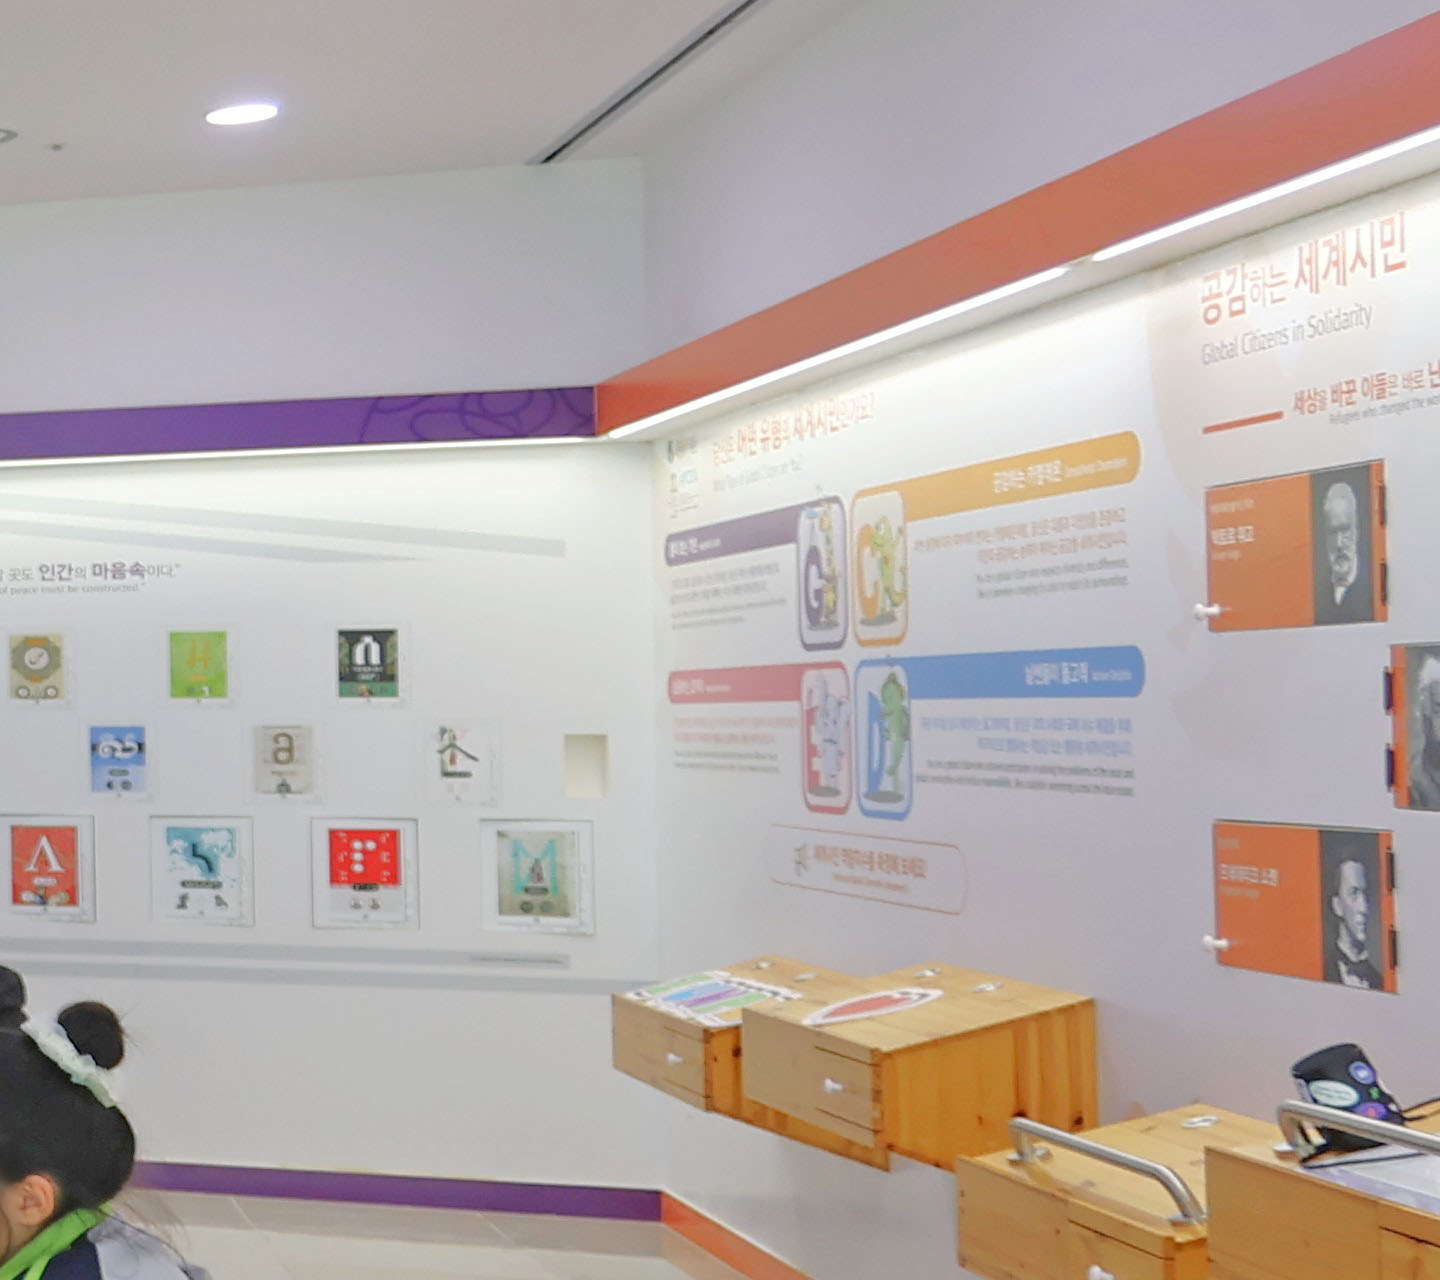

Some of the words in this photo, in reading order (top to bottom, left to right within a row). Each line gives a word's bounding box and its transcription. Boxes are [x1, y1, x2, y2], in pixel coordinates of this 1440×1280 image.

[1201, 263, 1288, 326] 공감하는
[1294, 211, 1407, 296] 세계시민
[1201, 337, 1239, 365] Global
[1242, 325, 1290, 355] Citizens
[1292, 321, 1305, 342] in
[1307, 303, 1373, 339] Solidarity
[39, 563, 87, 581] 인간의
